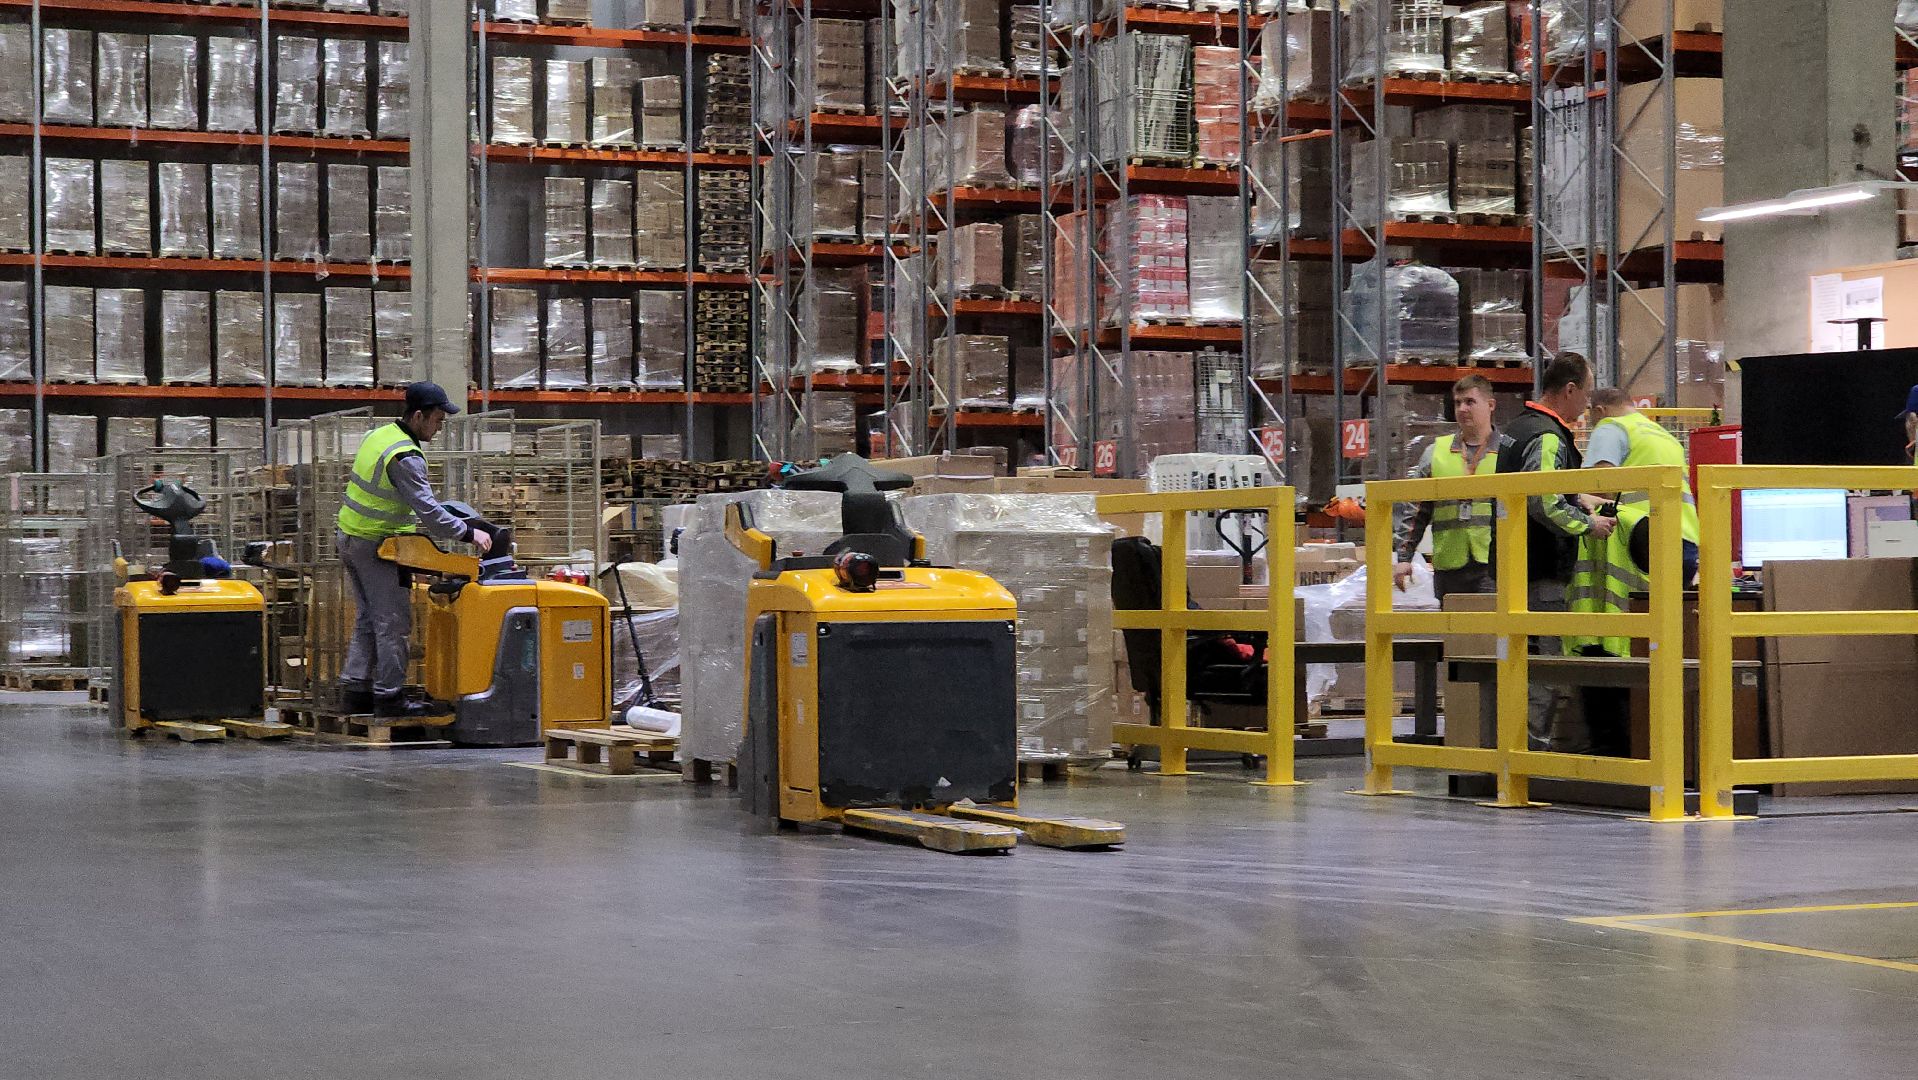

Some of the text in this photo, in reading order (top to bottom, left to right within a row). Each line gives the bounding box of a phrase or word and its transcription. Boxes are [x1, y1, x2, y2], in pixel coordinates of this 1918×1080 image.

[1264, 430, 1284, 457] 25
[1345, 423, 1366, 450] 24
[1097, 443, 1114, 468] 26
